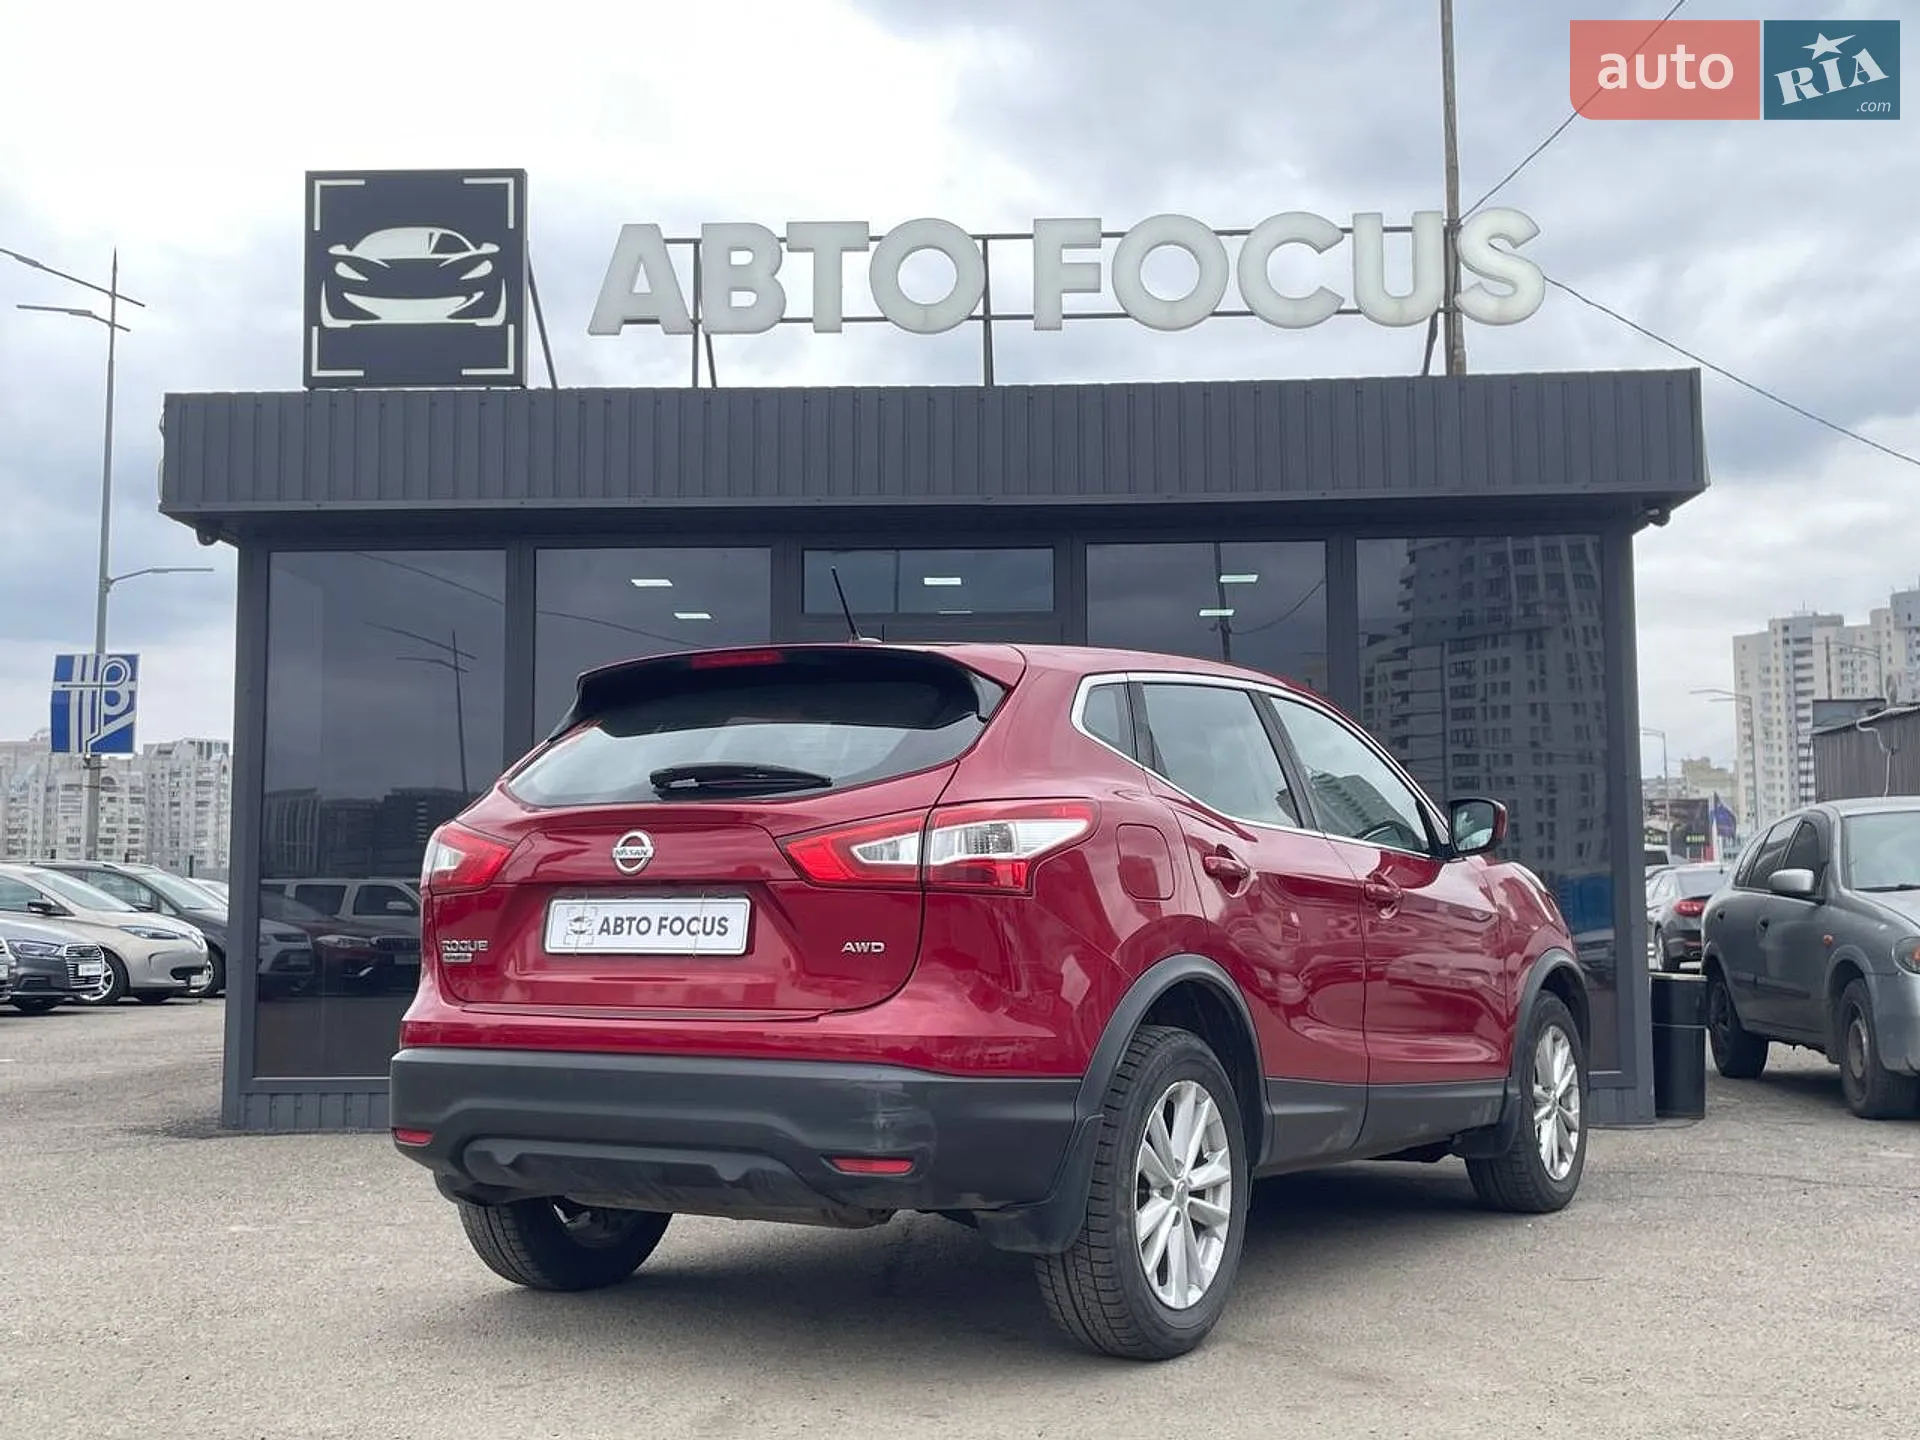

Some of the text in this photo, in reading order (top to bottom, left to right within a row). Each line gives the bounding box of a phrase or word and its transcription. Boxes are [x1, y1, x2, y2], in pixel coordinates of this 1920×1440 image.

[588, 208, 1545, 335] АВТО FOCUS
[615, 848, 649, 857] NISSAN
[598, 916, 730, 937] АВТО FOCUS
[441, 940, 489, 951] ROGUE
[841, 941, 885, 953] AWD
